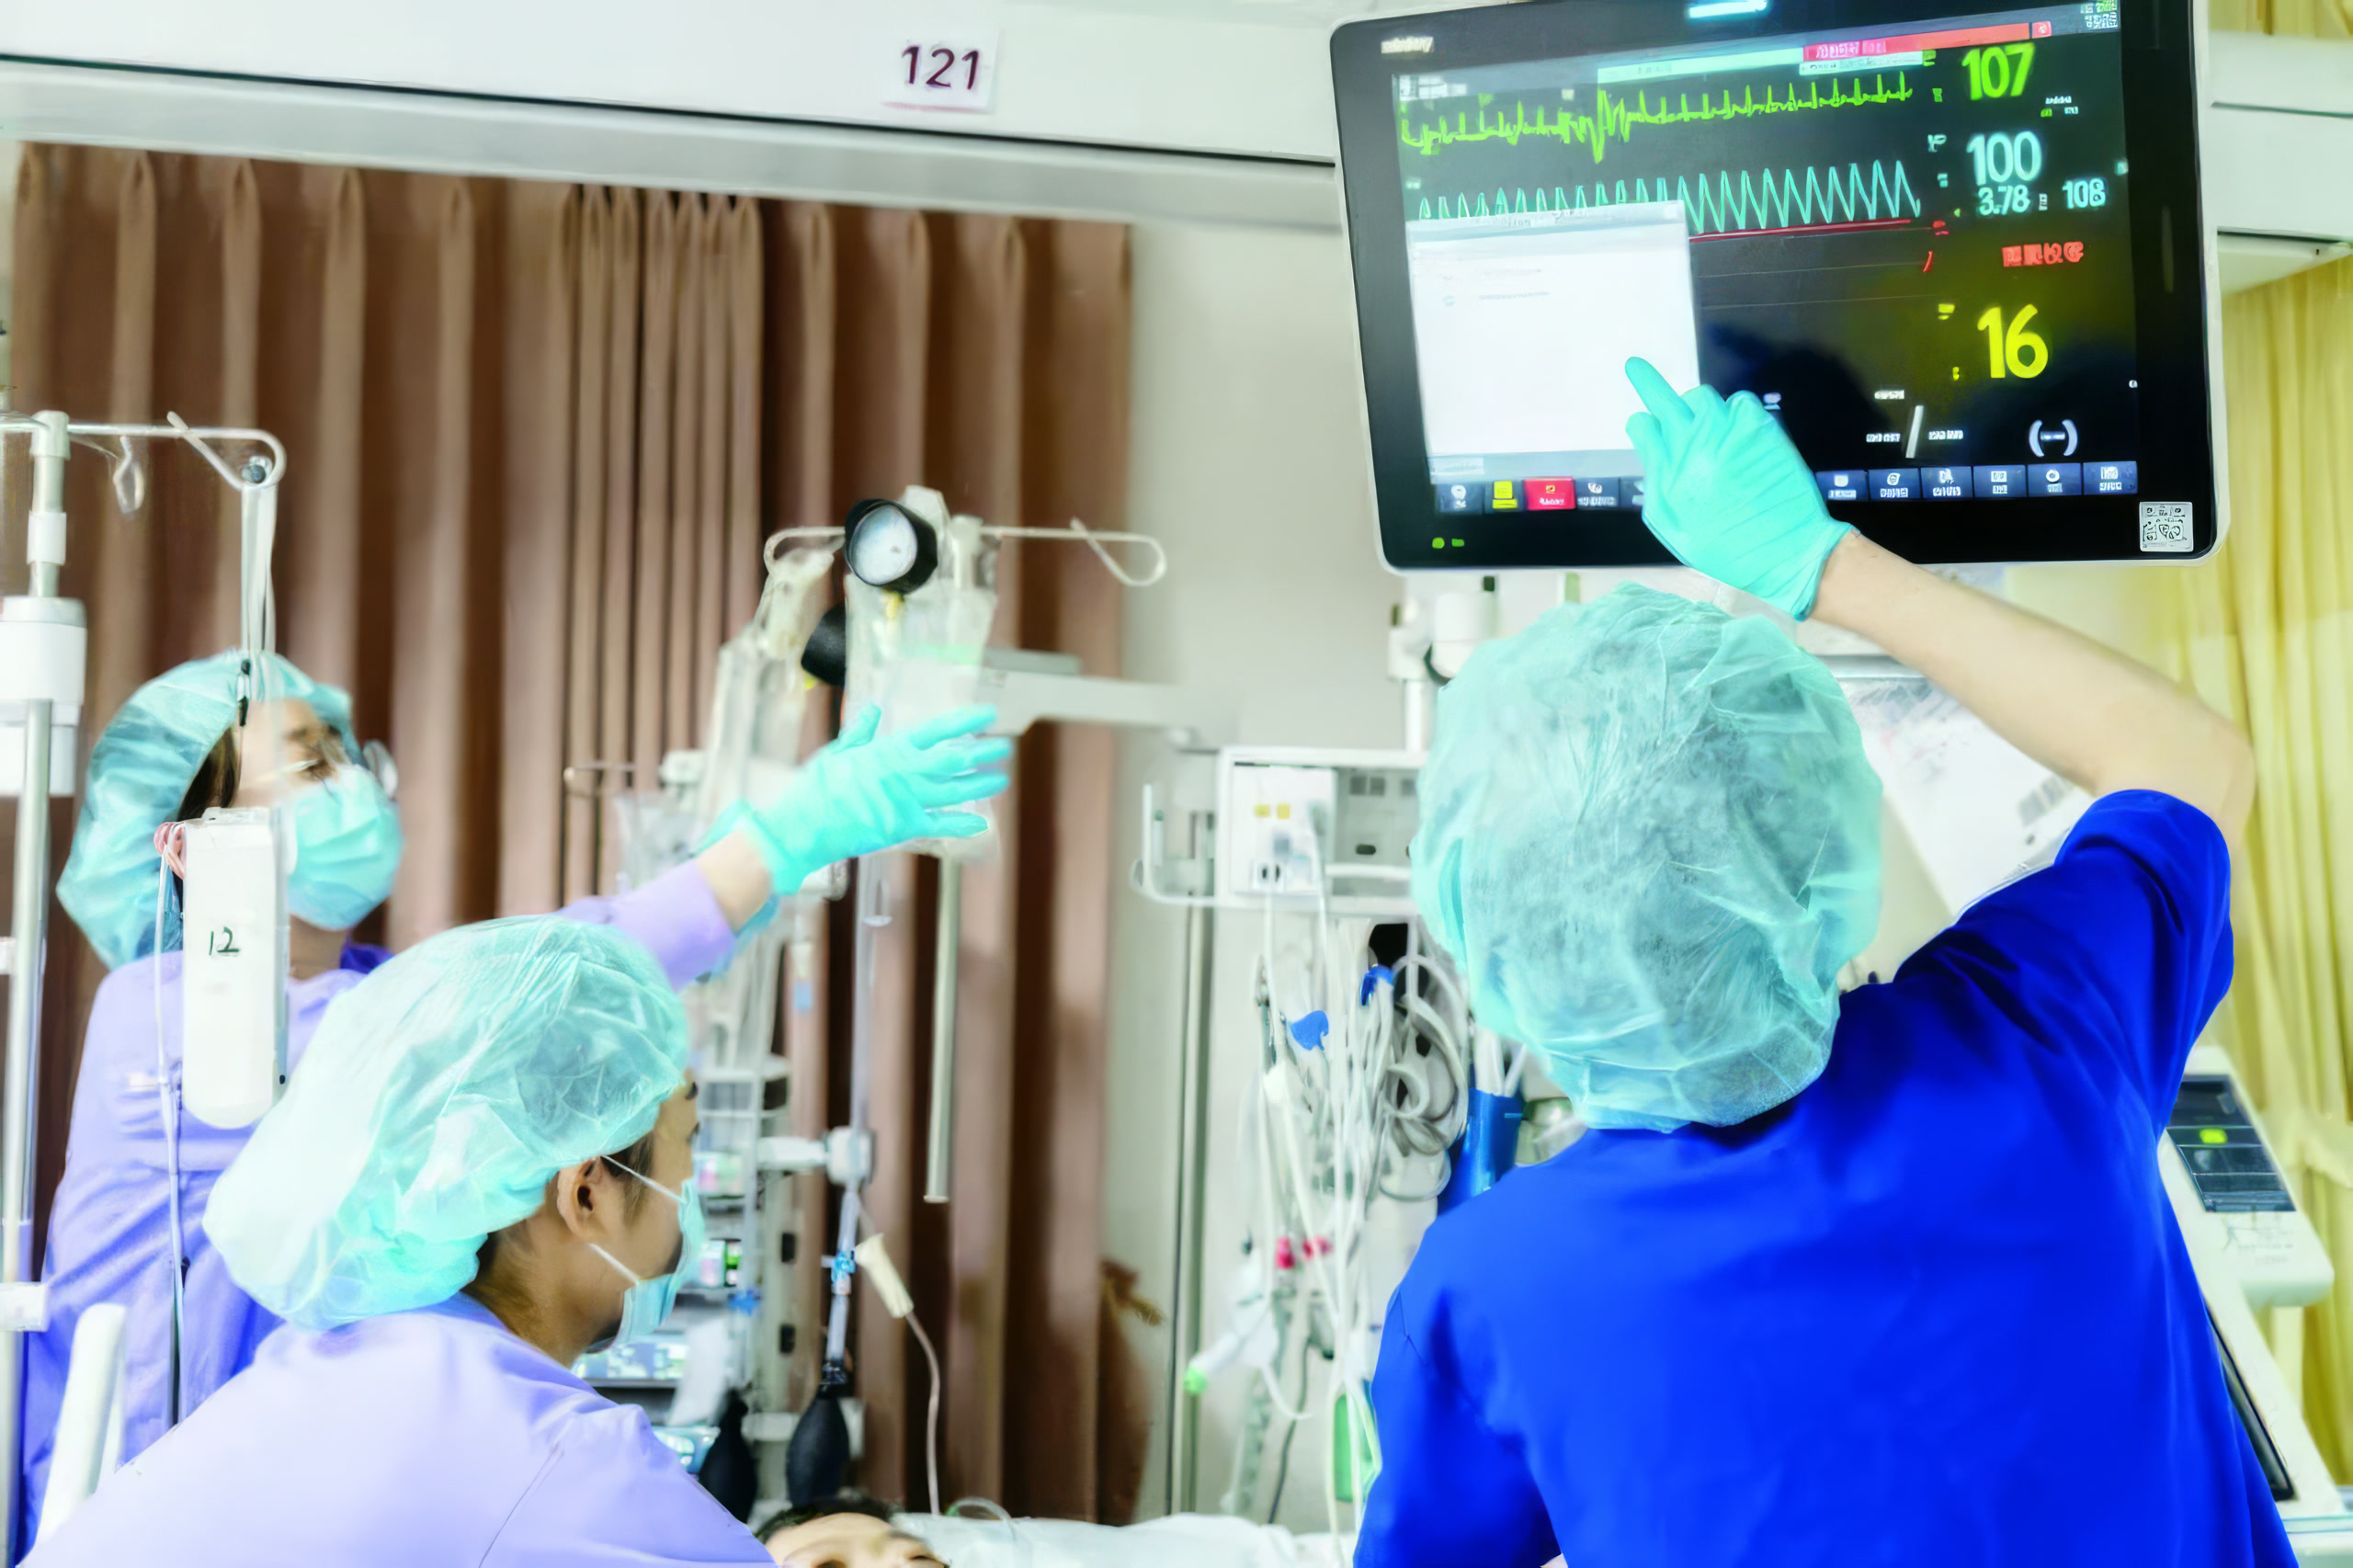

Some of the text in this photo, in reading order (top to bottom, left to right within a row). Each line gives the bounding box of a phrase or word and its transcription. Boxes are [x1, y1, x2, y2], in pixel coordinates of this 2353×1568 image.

[902, 46, 979, 90] 121
[1961, 42, 2036, 100] 107
[1966, 131, 2042, 186] 100
[1977, 185, 2030, 216] 3.78
[2062, 177, 2107, 210] 108
[1977, 303, 2049, 378] 16
[209, 926, 240, 956] 12
